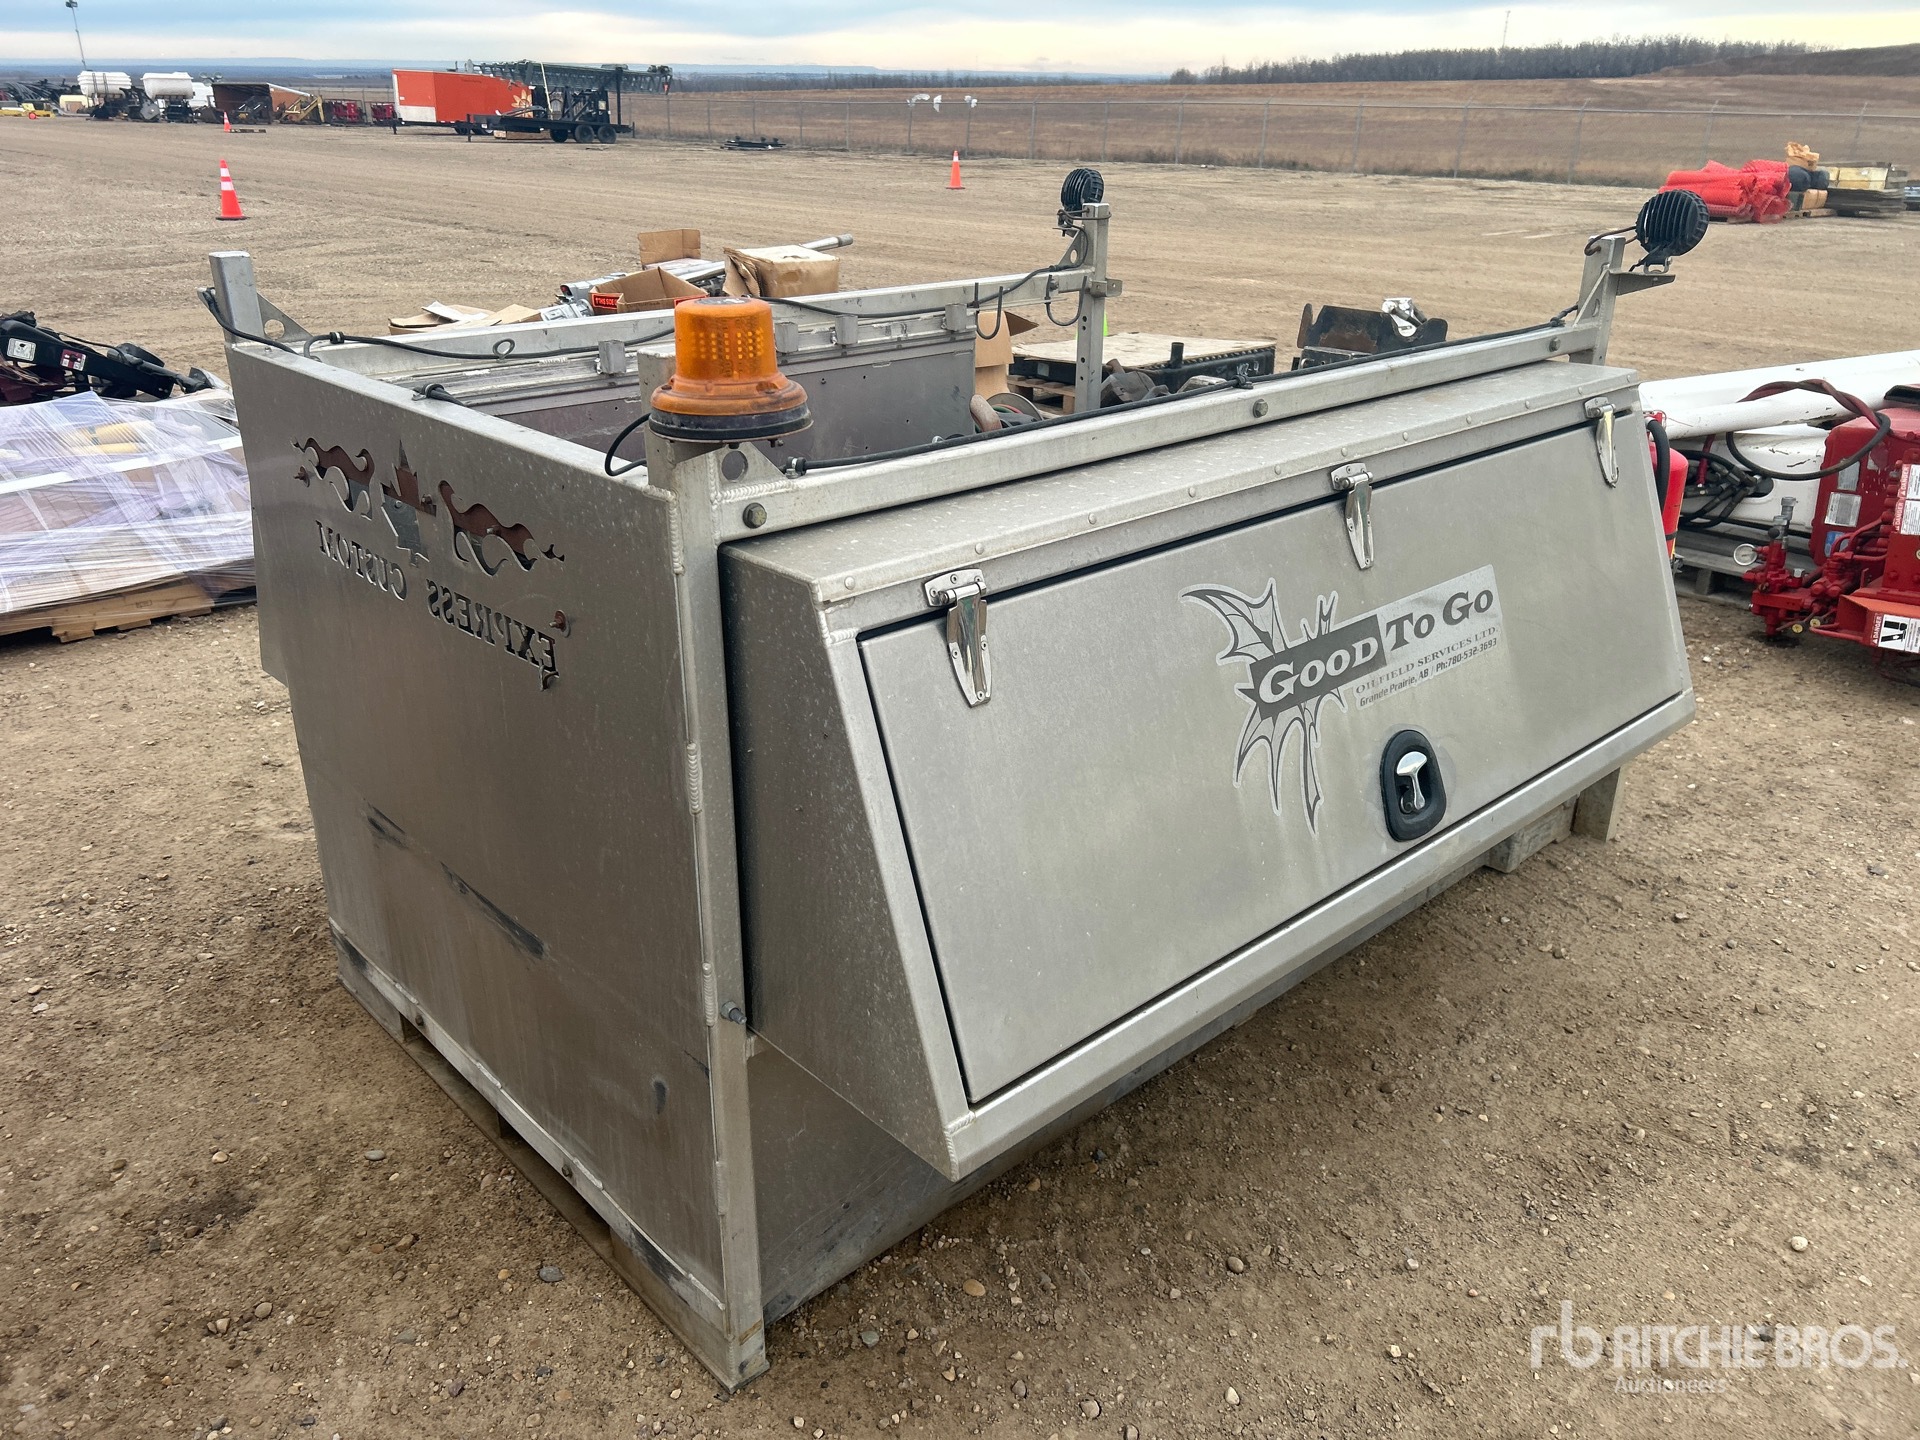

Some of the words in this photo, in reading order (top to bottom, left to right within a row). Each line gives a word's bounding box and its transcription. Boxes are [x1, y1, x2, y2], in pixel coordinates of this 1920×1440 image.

[1901, 467, 1910, 492] DANGER
[1894, 502, 1903, 527] DANGER
[1417, 636, 1472, 667] SERVICES
[1474, 626, 1499, 642] LTD.
[1258, 636, 1378, 704] GOOD
[1360, 688, 1388, 707] Grande
[1389, 676, 1417, 693] Prairie,
[1418, 669, 1429, 679] AB
[1436, 638, 1497, 672] Ph:780-532-3693
